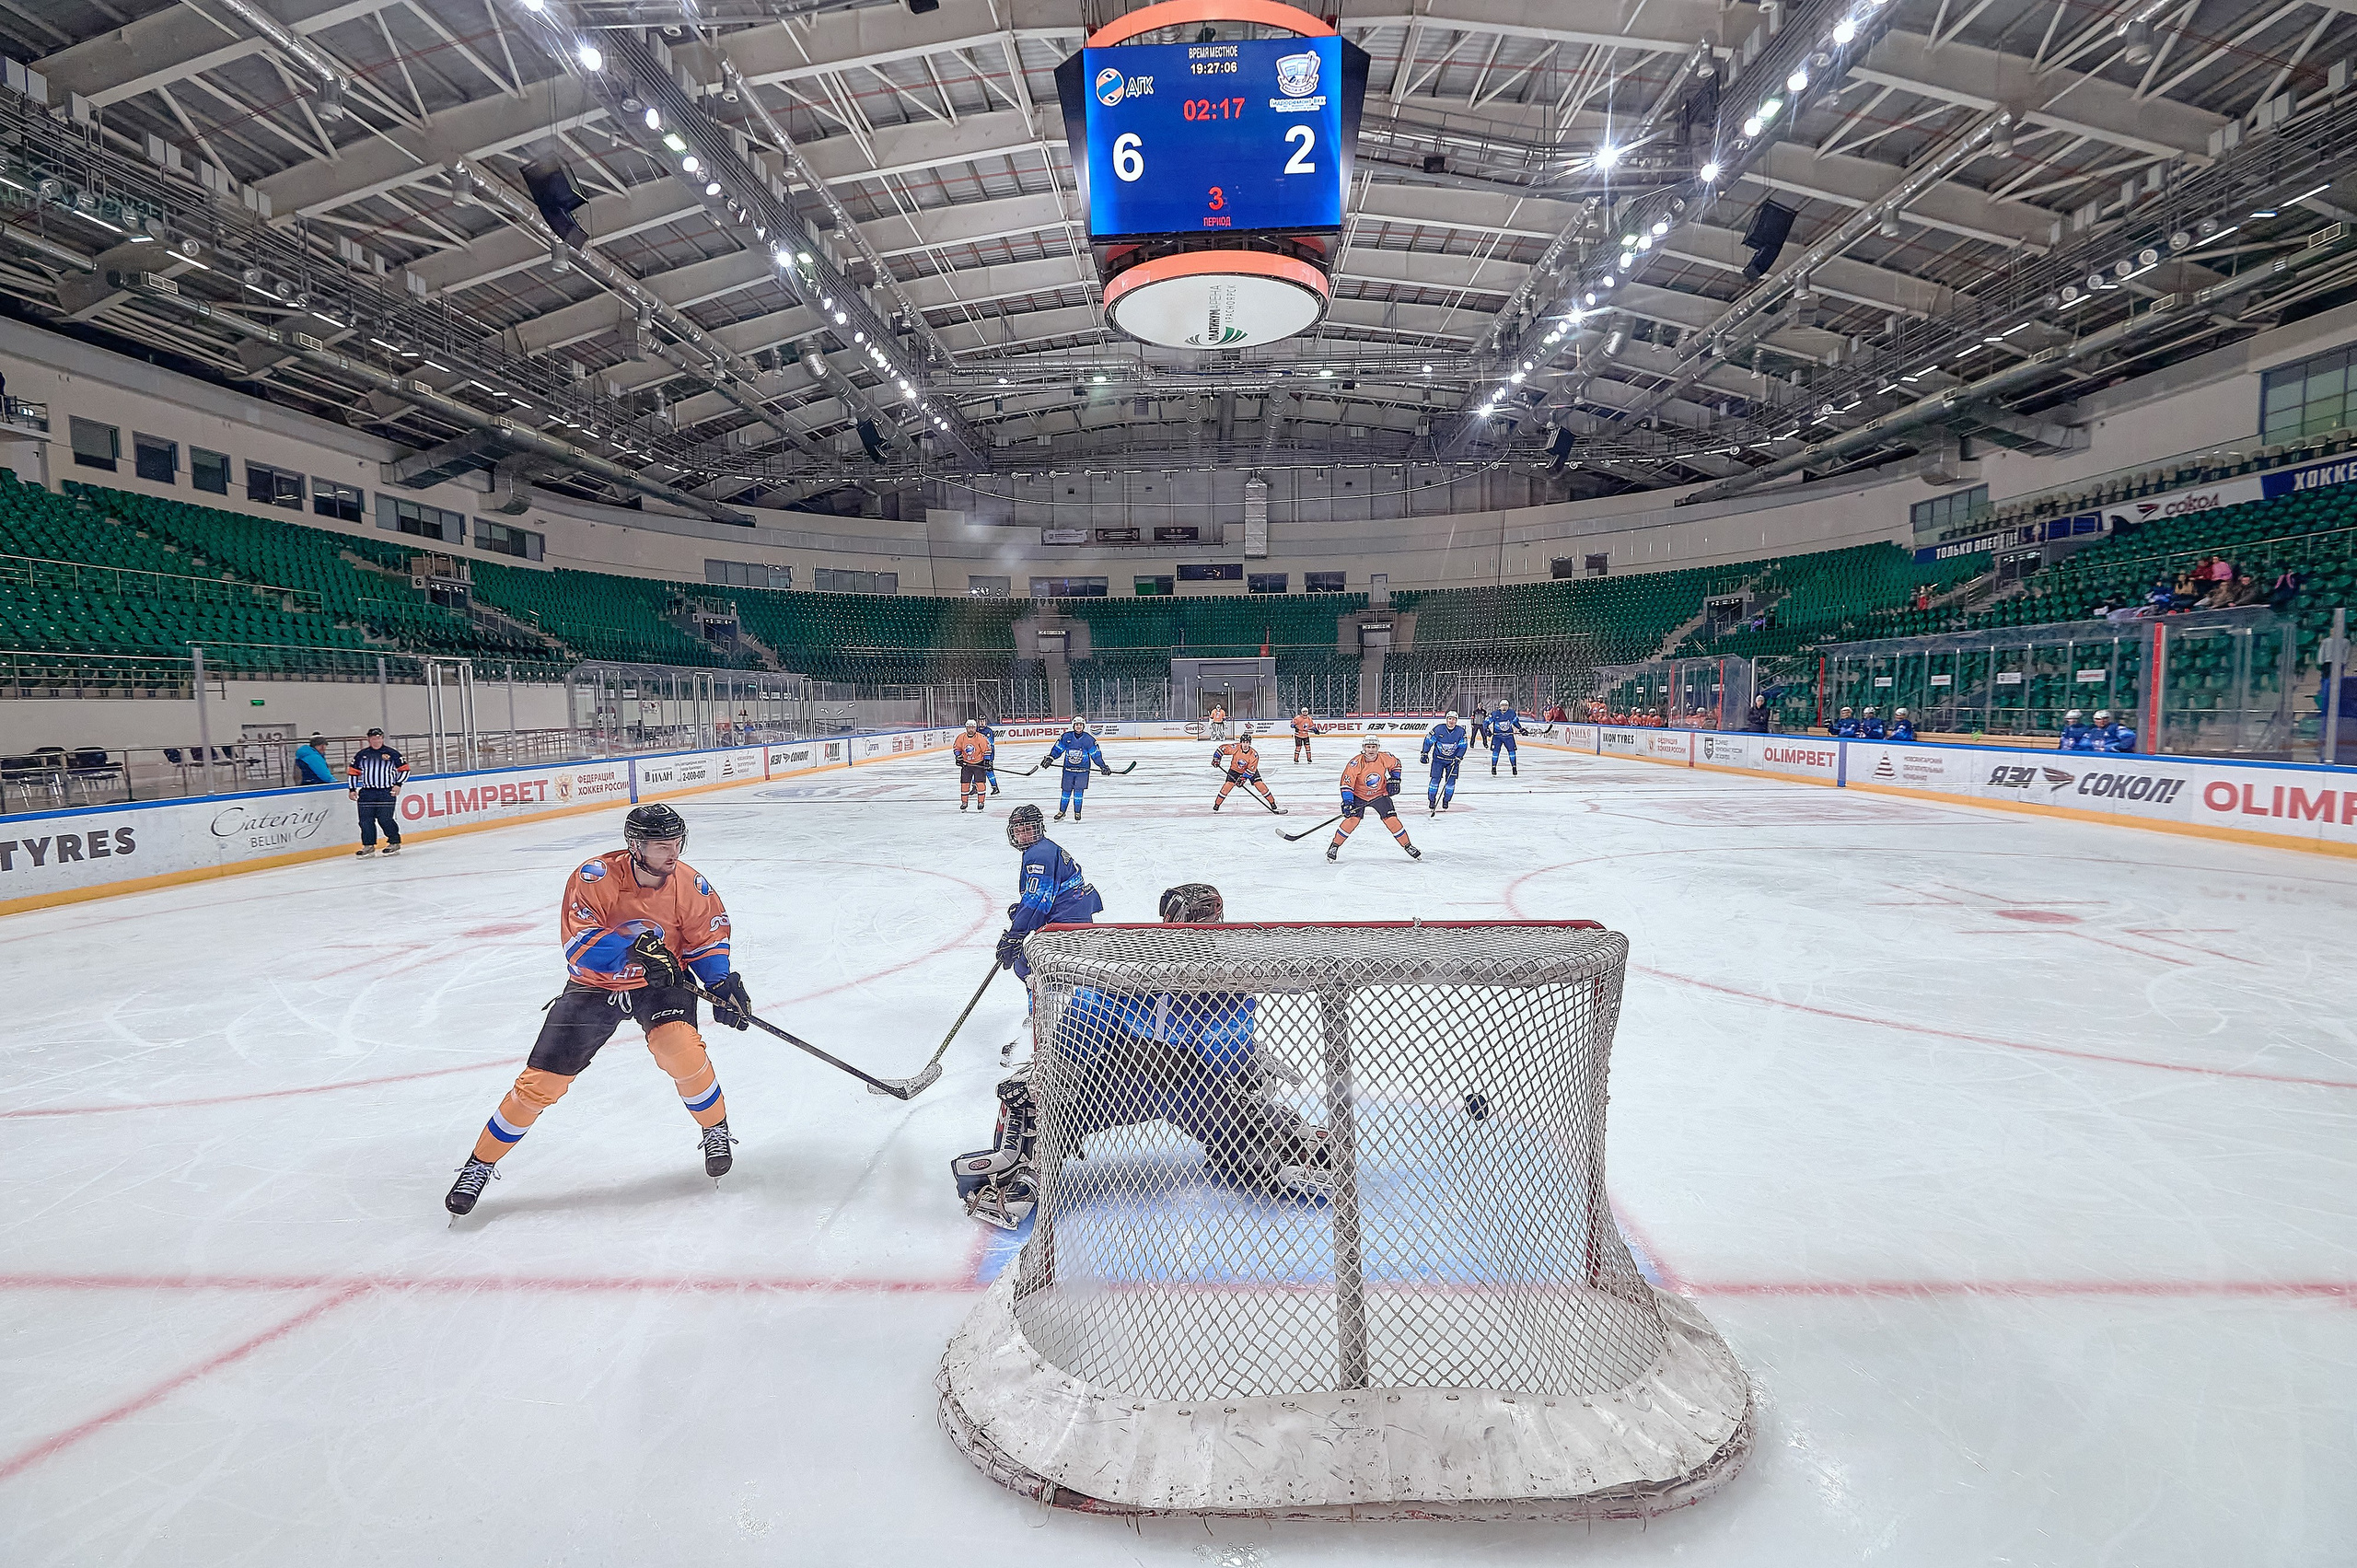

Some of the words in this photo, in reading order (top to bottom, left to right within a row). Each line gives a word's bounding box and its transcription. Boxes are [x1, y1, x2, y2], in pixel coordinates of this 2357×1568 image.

[1189, 47, 1209, 58] ВРЕМЯ
[1210, 45, 1238, 57] МЕСТНОЕ
[1190, 62, 1237, 75] 19:27:06
[1183, 98, 1246, 121] 02:17
[1112, 133, 1144, 182] 6
[1283, 124, 1316, 175] 2
[1208, 186, 1224, 210] 3
[1203, 215, 1231, 227] ПЕРИОД
[1935, 541, 1972, 560] ТОЛЬКО
[1008, 727, 1068, 738] OLIMPBET
[1315, 723, 1363, 731] IMPBET
[1618, 734, 1634, 744] TYRES
[1764, 747, 1836, 768] OLIMPBET
[577, 771, 615, 784] ФЕДЕРАЦИЯ
[578, 785, 605, 796] ХОККЕЯ
[604, 782, 630, 792] РОССИИ
[2077, 772, 2186, 804] СОКОЛ!
[401, 780, 548, 821] OLIMPBET
[211, 807, 329, 840] Catering
[250, 832, 292, 848] BELLINI
[0, 826, 135, 872] TYRES
[651, 1008, 685, 1021] CCM
